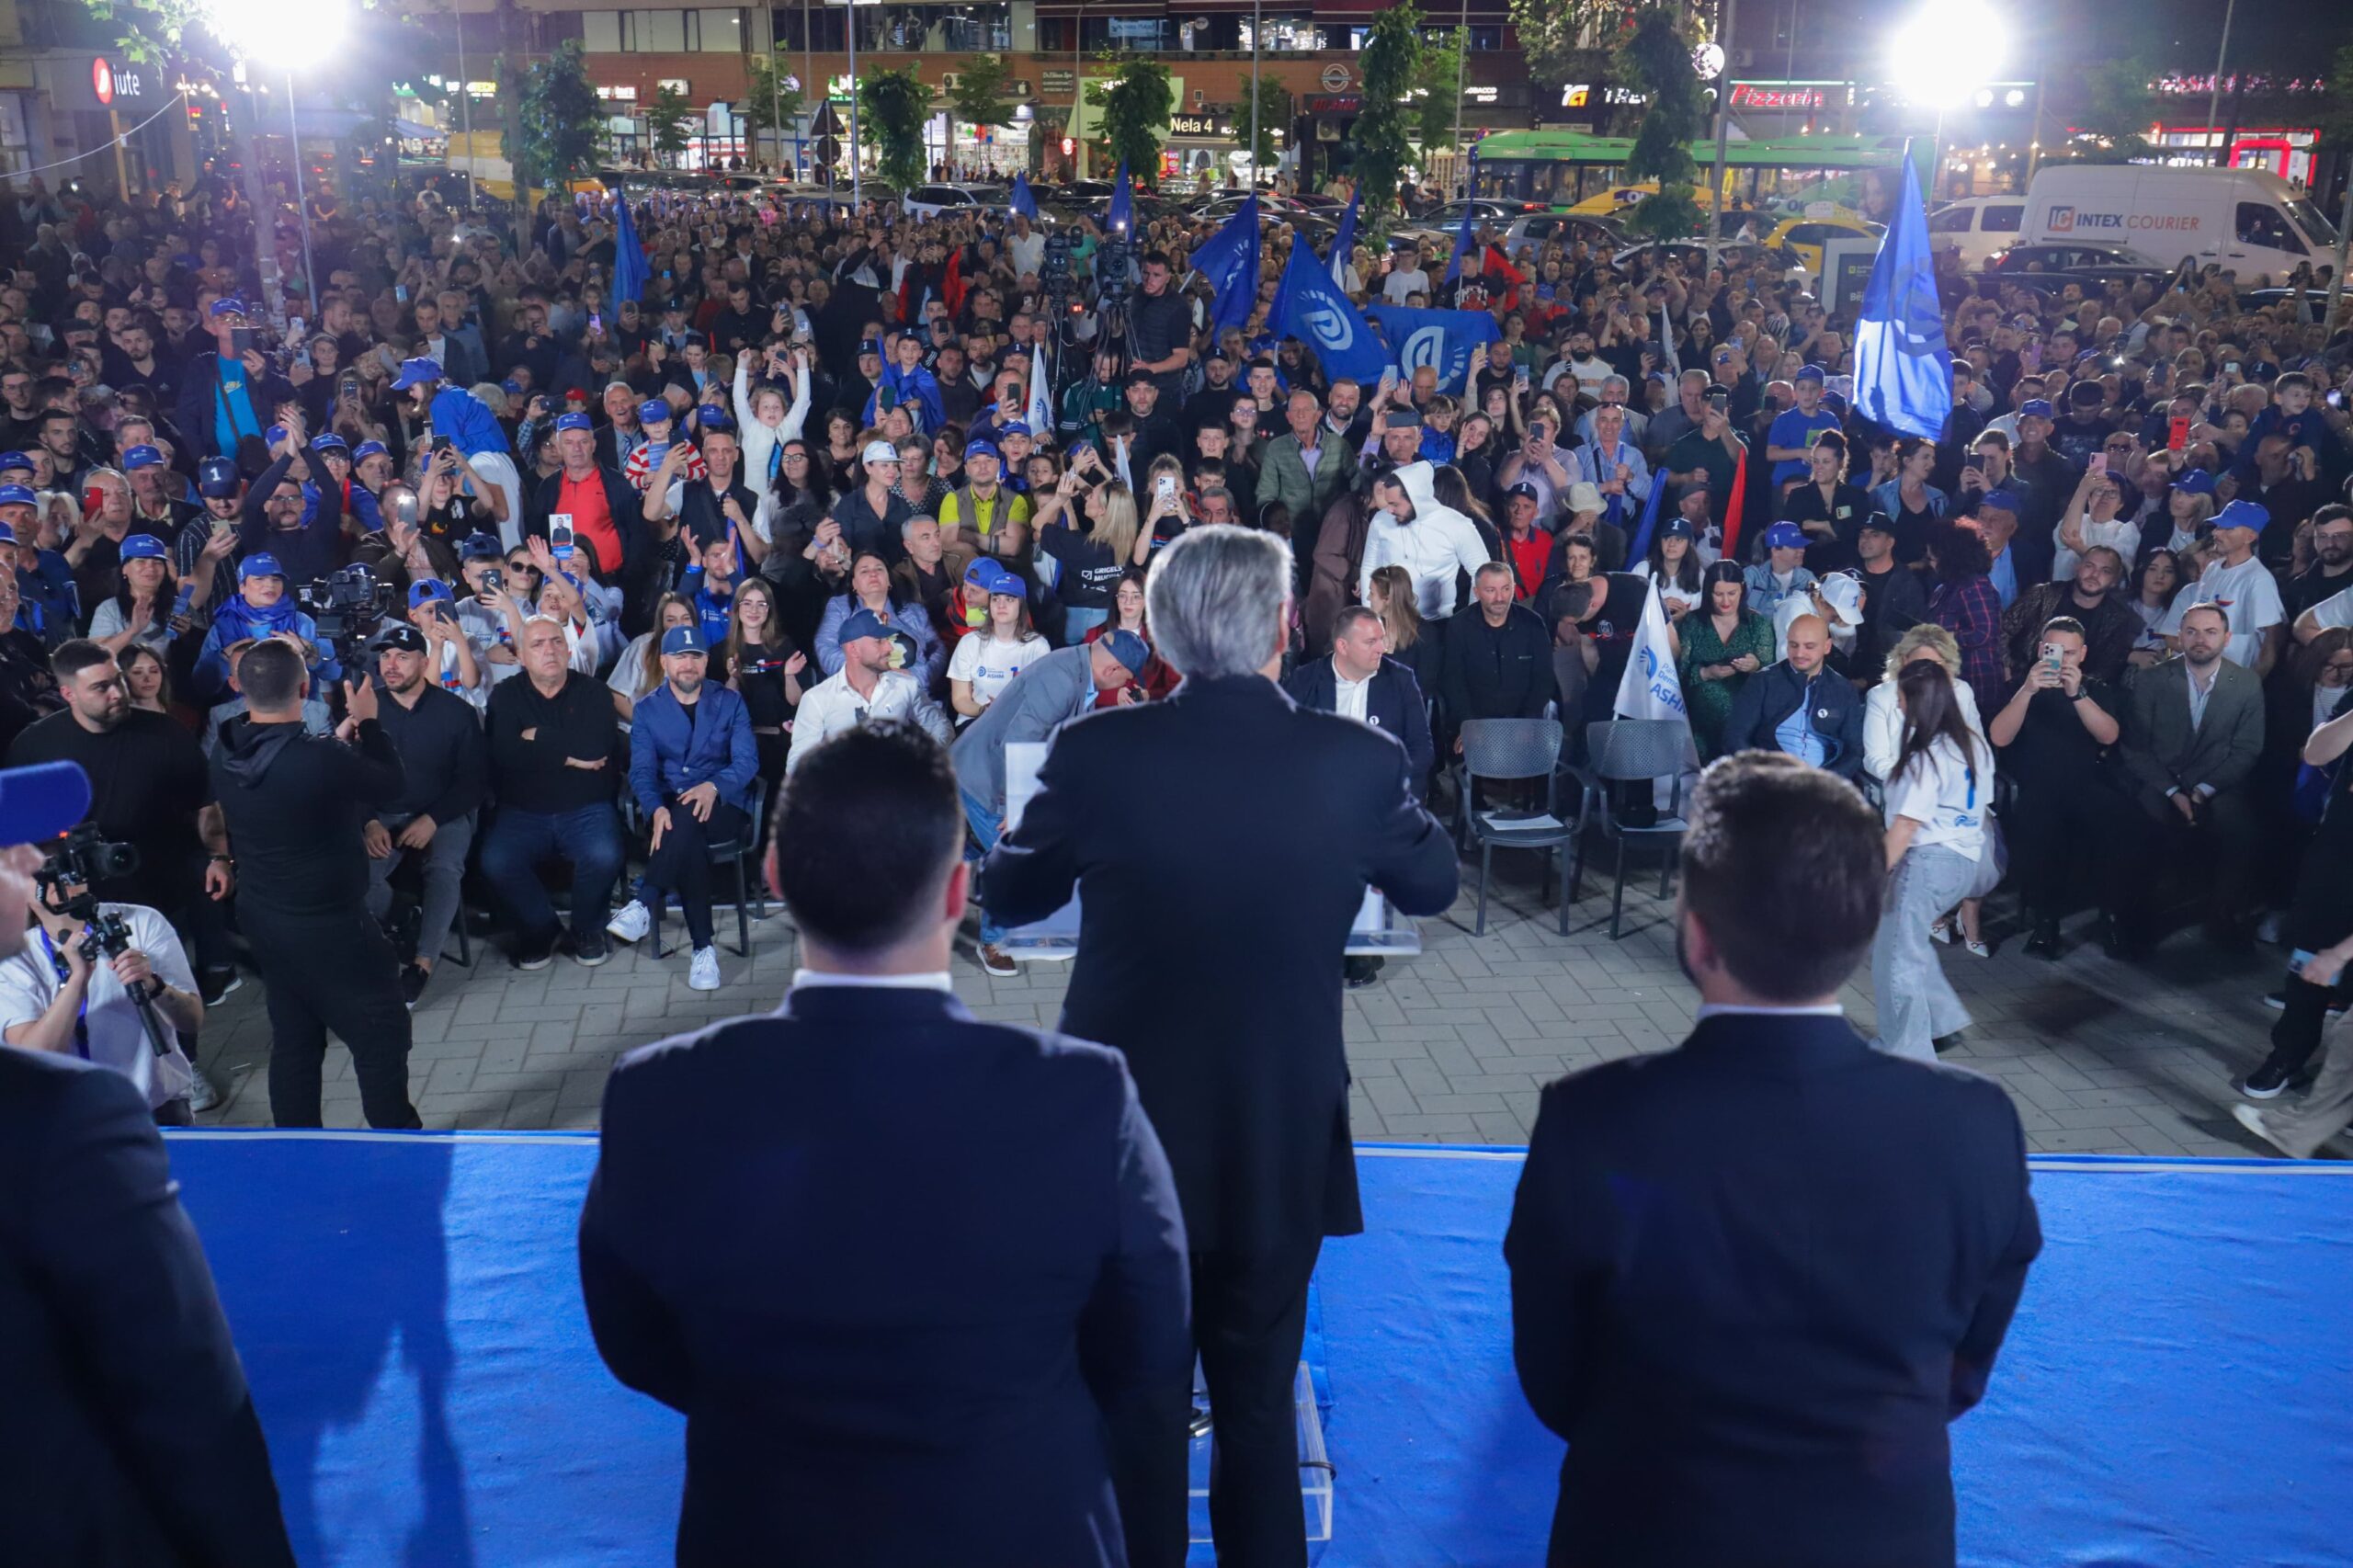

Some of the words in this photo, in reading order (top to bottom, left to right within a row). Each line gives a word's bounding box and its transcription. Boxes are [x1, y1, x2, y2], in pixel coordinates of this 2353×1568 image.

[112, 63, 141, 96] iute
[1170, 117, 1201, 133] Nela
[1203, 119, 1213, 132] 4
[2076, 213, 2123, 227] INTEX
[2127, 215, 2200, 230] COURIER
[210, 466, 222, 482] 1
[1521, 483, 1528, 493] 1
[1670, 519, 1680, 530] 1
[1866, 514, 1874, 524] 1
[1773, 533, 1779, 545] 1
[399, 630, 410, 642] 1
[683, 630, 694, 645] 1
